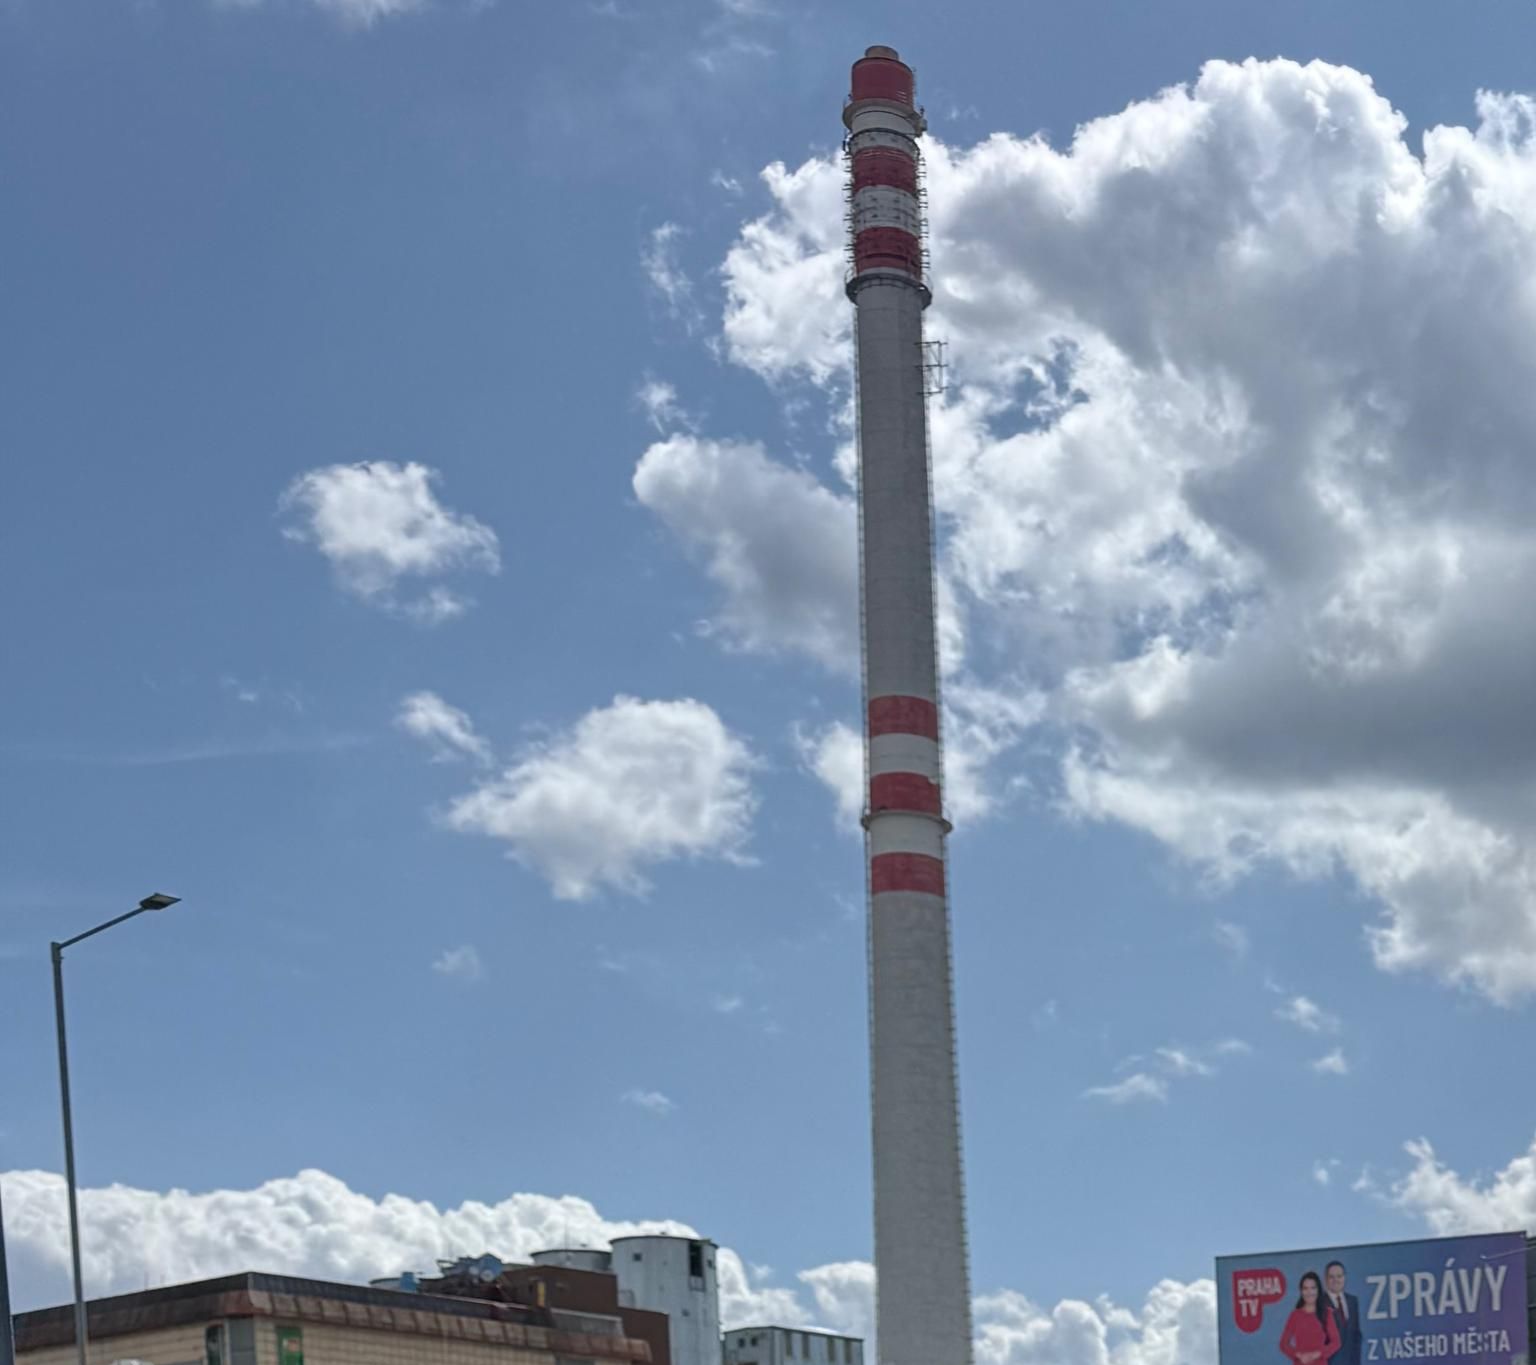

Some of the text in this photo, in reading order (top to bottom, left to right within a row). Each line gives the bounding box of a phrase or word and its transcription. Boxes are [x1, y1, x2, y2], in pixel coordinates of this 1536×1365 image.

[1238, 1277, 1282, 1297] PRAHA
[1366, 1258, 1507, 1320] ZPRÁVY
[1239, 1299, 1259, 1317] TV
[1367, 1339, 1379, 1360] Z
[1382, 1331, 1449, 1359] VAŠEHO
